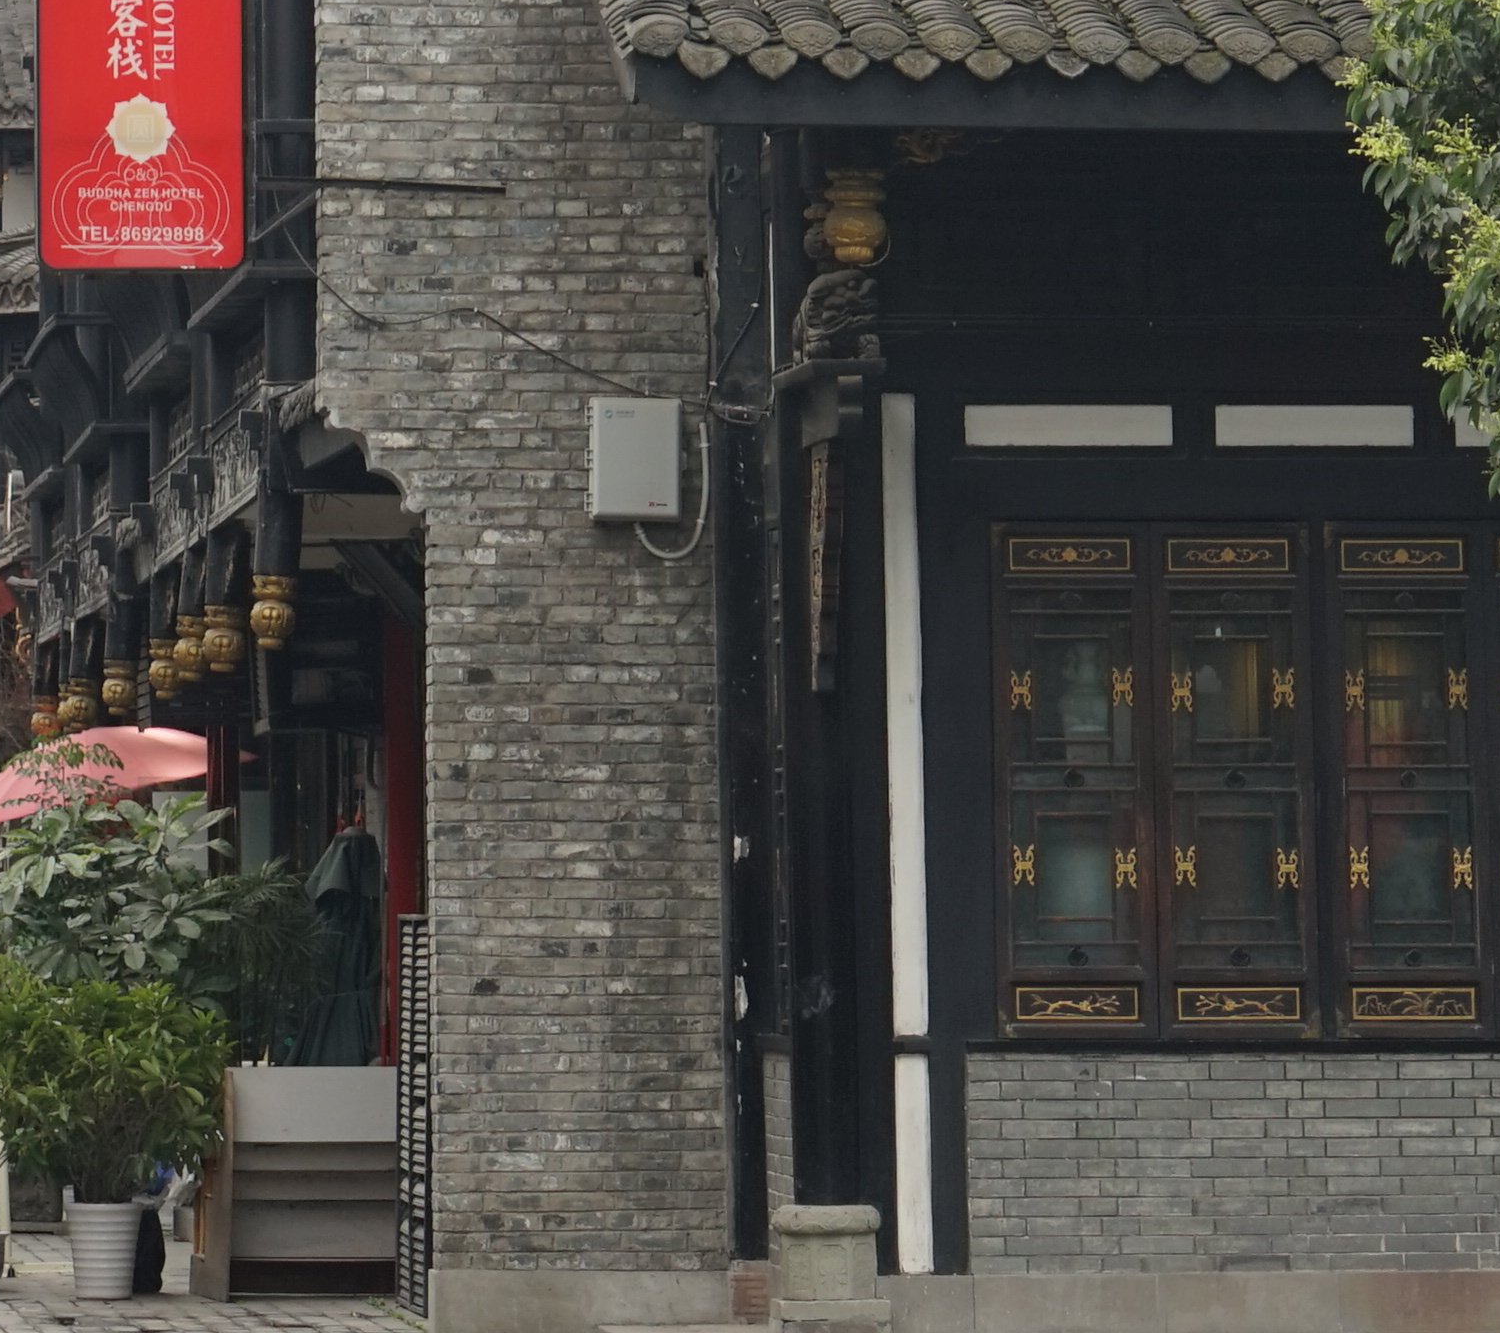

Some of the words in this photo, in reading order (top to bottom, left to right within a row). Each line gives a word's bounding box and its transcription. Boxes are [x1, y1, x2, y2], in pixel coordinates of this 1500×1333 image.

[78, 187, 131, 199] BUDDHA
[133, 188, 159, 199] ZEN
[161, 188, 204, 199] HOTEL
[110, 201, 173, 212] CHENGDU
[78, 226, 205, 241] TEL:86929898
